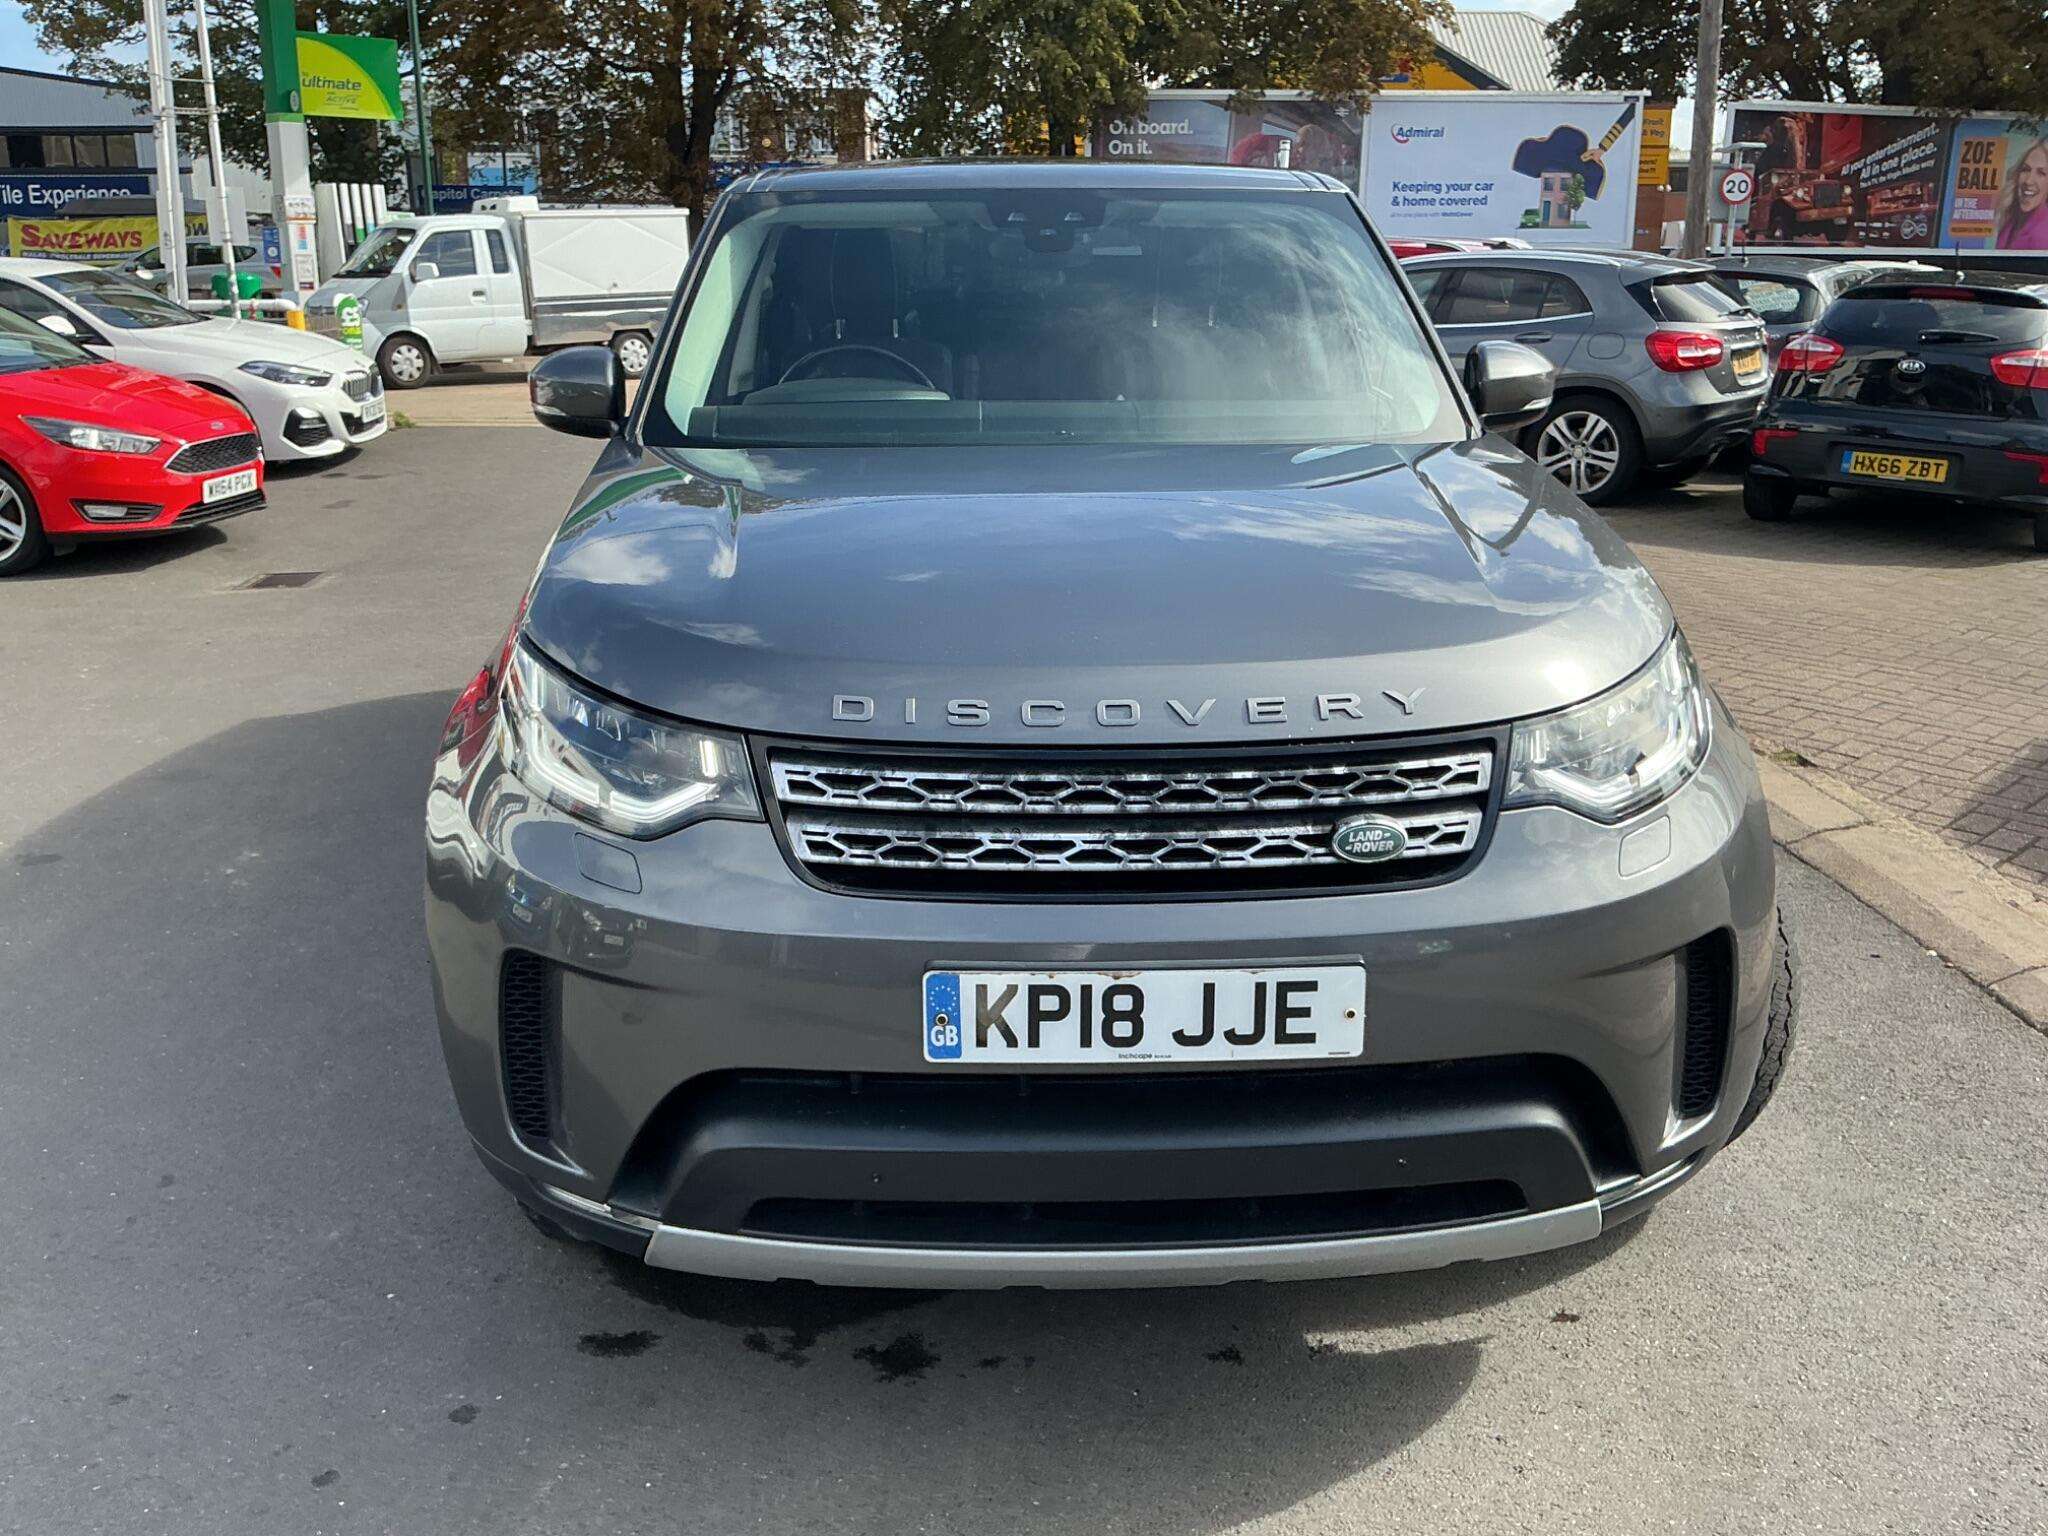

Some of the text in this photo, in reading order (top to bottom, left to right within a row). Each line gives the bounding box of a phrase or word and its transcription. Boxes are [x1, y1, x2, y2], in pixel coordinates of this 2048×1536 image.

[302, 76, 361, 90] ultimate
[1138, 119, 1193, 135] board.
[1395, 126, 1445, 139] Admiral
[1109, 138, 1153, 155] On it.
[1866, 122, 1940, 164] entertainment.
[1961, 141, 1995, 163] ZOE
[1881, 157, 1899, 171] one
[1900, 142, 1938, 167] place.
[1392, 181, 1494, 194] Keeping your car
[1726, 180, 1749, 193] 20
[1957, 167, 1999, 190] BALL
[0, 184, 23, 204] ile
[421, 188, 468, 202] apitol
[1391, 195, 1488, 206] & home covered
[1902, 362, 1920, 371] KIA
[1854, 455, 1902, 475] HX66
[1906, 459, 1944, 479] ZBT
[833, 687, 1425, 727] DISCOVERY
[975, 980, 1318, 1048] KP18 JJE
[931, 1025, 958, 1046] GB
